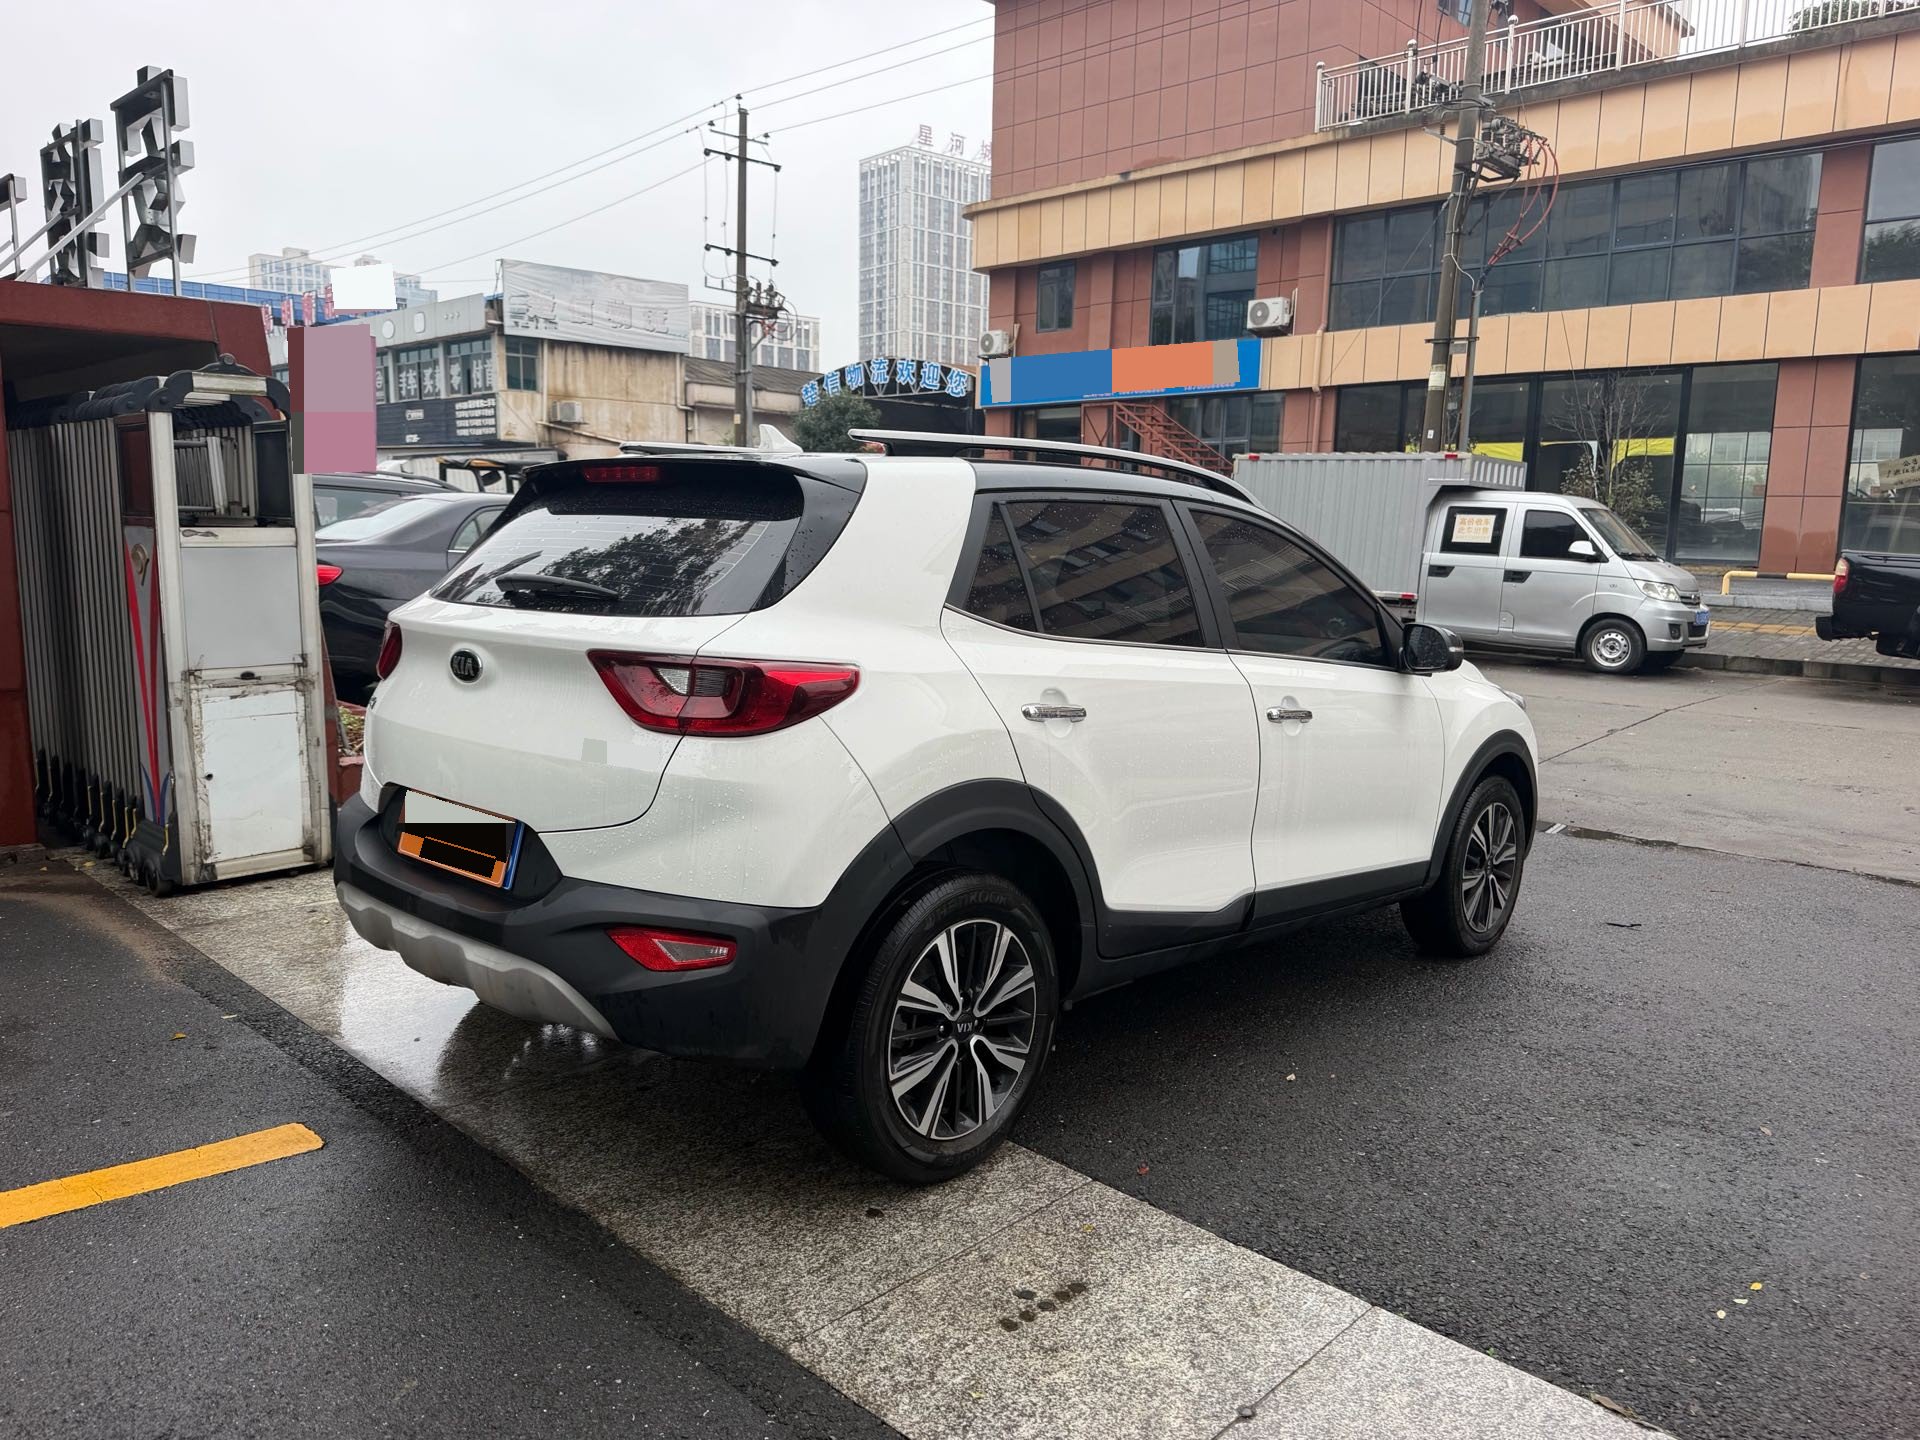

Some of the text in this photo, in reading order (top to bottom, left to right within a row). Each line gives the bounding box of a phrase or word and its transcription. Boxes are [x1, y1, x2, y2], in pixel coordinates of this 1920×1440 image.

[801, 357, 970, 408] 楚信物流欢迎您
[453, 655, 475, 677] KIA
